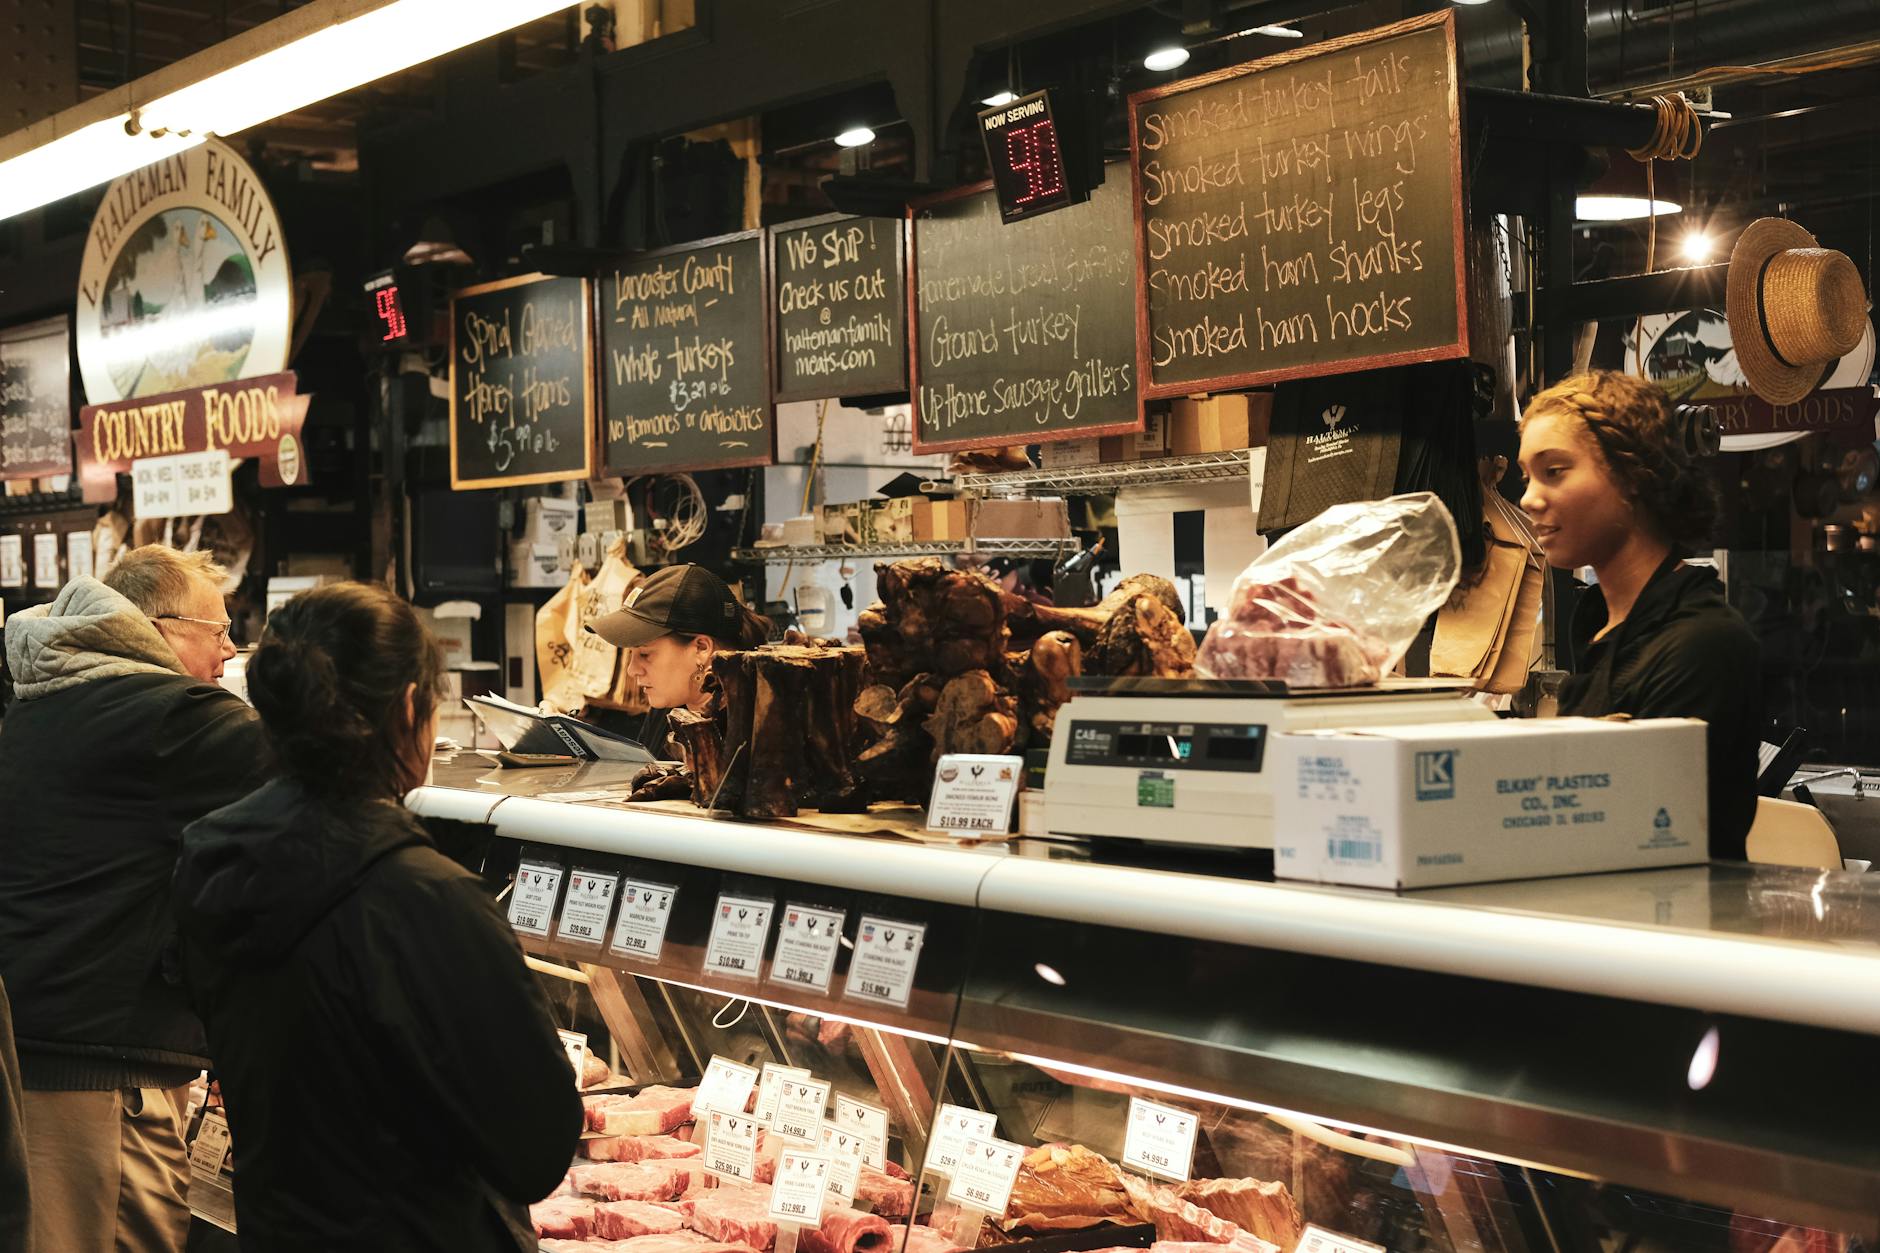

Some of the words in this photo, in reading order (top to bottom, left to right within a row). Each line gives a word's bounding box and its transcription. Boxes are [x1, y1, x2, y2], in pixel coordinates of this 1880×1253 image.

[985, 113, 1006, 130] NOW
[1007, 100, 1044, 122] SERVING
[1143, 89, 1247, 150] Smoked
[1250, 70, 1336, 128] turkey
[1347, 52, 1409, 105] tails
[1008, 119, 1063, 203] 90
[1144, 148, 1244, 205] Smoked
[1252, 136, 1331, 183] turkey
[1344, 114, 1430, 174] wings
[83, 279, 98, 308] L.
[95, 150, 187, 264] HALTEMAN
[205, 149, 276, 269] FAMILY
[1148, 201, 1249, 260] Smoked
[1254, 191, 1333, 245] turkey
[1353, 177, 1404, 238] legs
[786, 231, 817, 272] We
[1149, 252, 1249, 301] Smoked
[1260, 244, 1319, 292] ham
[614, 263, 682, 311] Lancaster
[682, 252, 735, 296] County
[779, 281, 825, 315] Check
[828, 279, 849, 302] us
[854, 268, 886, 301] out
[631, 305, 650, 330] All
[655, 296, 698, 328] Natural
[819, 307, 832, 325] @
[930, 314, 999, 368] Ground
[1003, 304, 1081, 359] turkey
[1152, 313, 1247, 367] Smoked
[1256, 307, 1318, 352] ham
[1326, 291, 1412, 341] hocks
[613, 342, 662, 386] Whole
[667, 335, 735, 381] turkeys
[795, 348, 877, 377] meats.com
[993, 378, 1063, 424] Sausage
[1061, 358, 1133, 420] grillers
[1771, 396, 1855, 428] FOODS
[93, 400, 187, 465] COUNTRY
[202, 385, 280, 453] FOODS
[608, 417, 624, 443] No
[626, 412, 680, 445] Hormones
[685, 414, 696, 429] or
[700, 404, 764, 435] antibiotics
[1075, 729, 1096, 740] CAS
[1547, 773, 1610, 790] PLASTICS
[940, 815, 968, 828] $10.99
[970, 817, 994, 829] EACH
